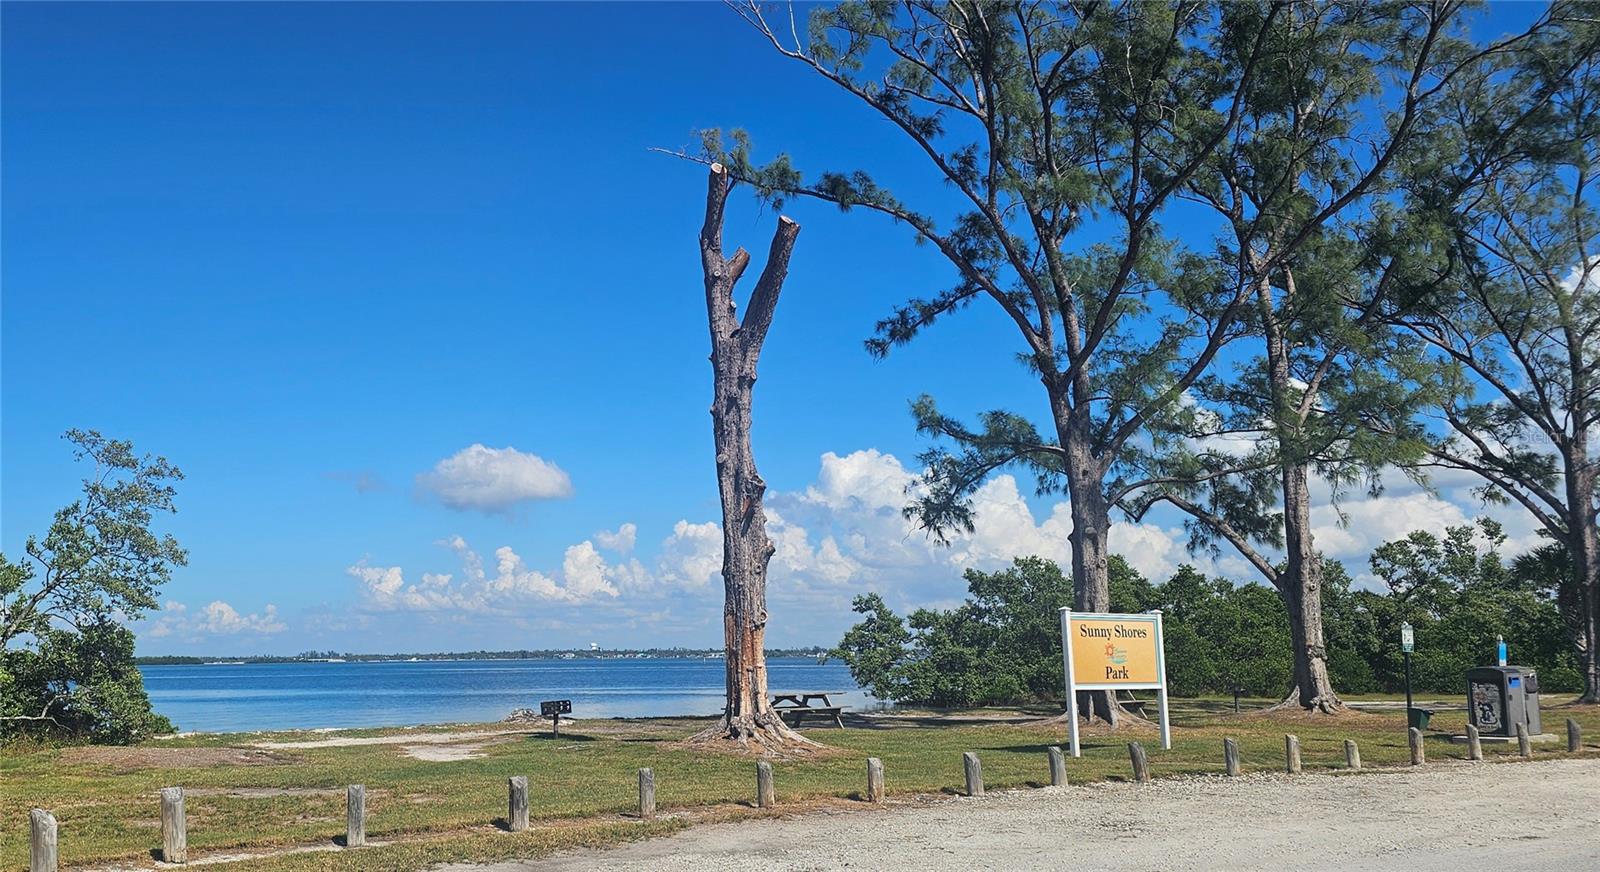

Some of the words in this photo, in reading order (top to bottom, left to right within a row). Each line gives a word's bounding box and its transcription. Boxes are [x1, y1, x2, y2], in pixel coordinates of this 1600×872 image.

[1080, 624, 1112, 640] Sunny
[1114, 625, 1147, 638] Shores
[1106, 666, 1129, 679] Park
